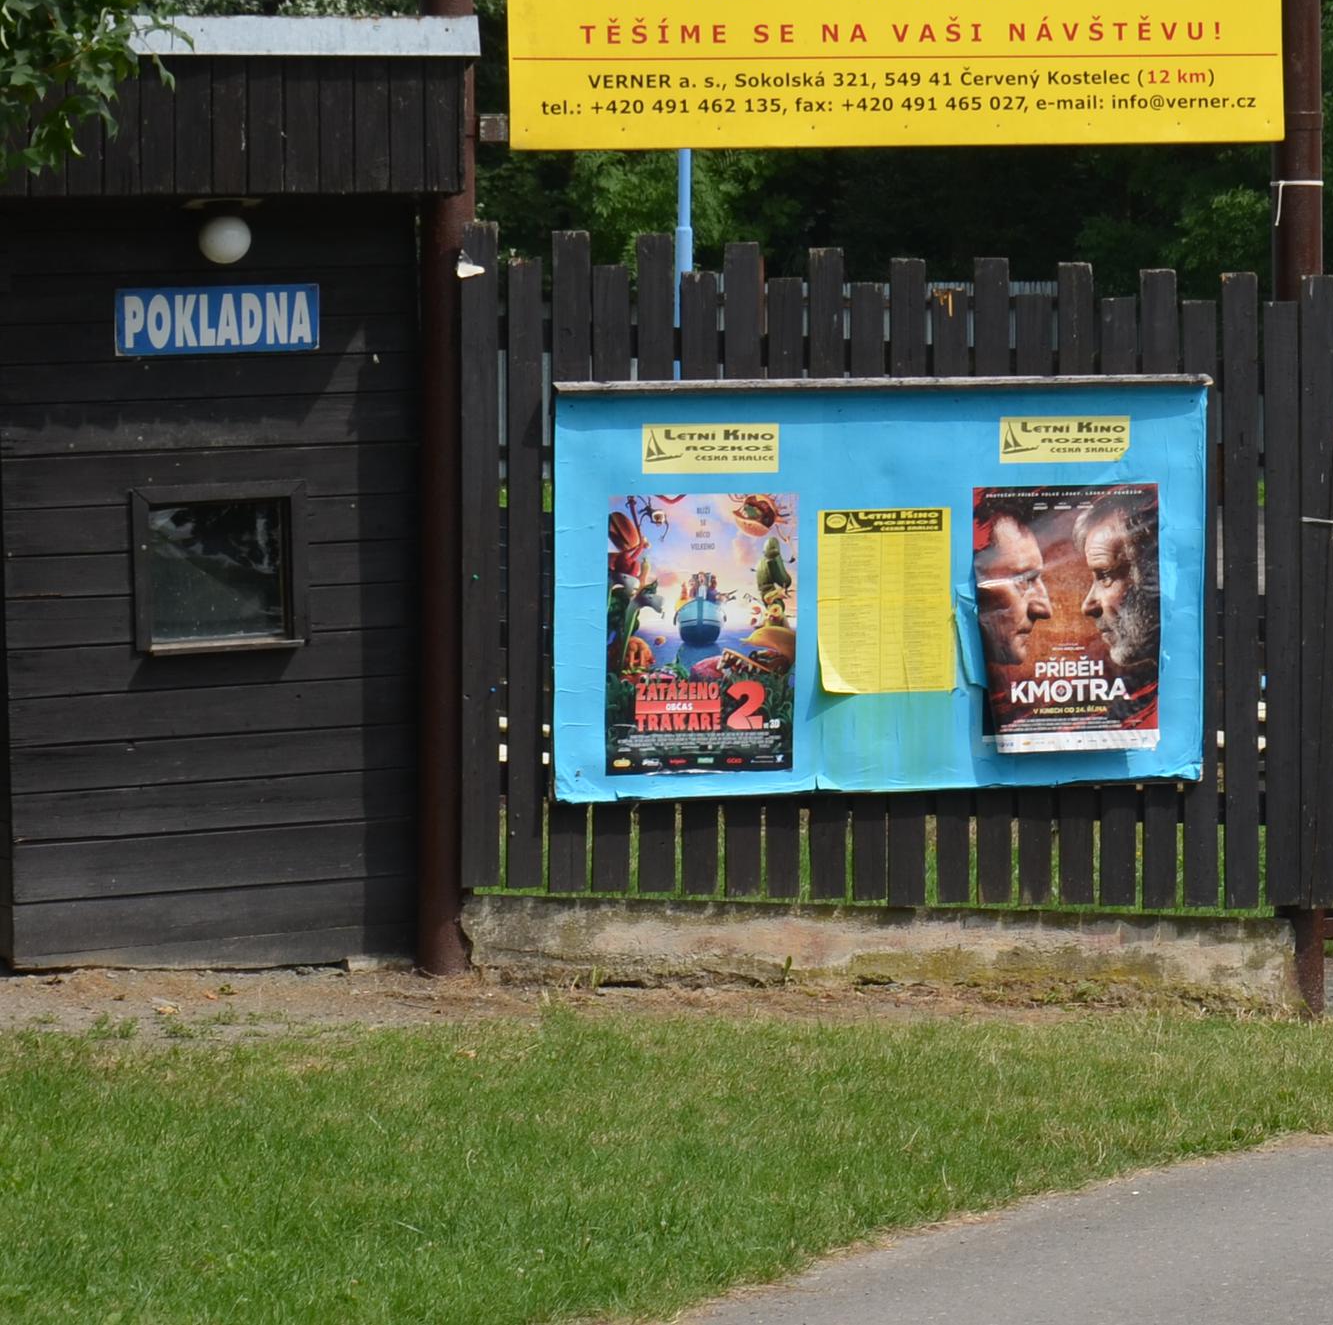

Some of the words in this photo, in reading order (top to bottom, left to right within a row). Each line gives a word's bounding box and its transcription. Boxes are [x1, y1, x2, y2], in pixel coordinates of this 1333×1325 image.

[579, 17, 727, 45] TĚŠÍME
[753, 23, 794, 44] SE
[821, 23, 868, 44] NA
[891, 15, 982, 43] VAŠI
[1008, 15, 1221, 42] NÁVŠTĚVU!
[587, 73, 672, 90] VERNER
[678, 76, 697, 89] a.
[704, 76, 727, 92] s.,
[734, 70, 825, 88] Sokolská
[833, 72, 877, 90] 321,
[884, 71, 921, 87] 549
[928, 71, 953, 87] 41
[959, 66, 1041, 90] Červený
[1047, 69, 1130, 86] Kostelec
[540, 99, 582, 116] tel.:
[590, 99, 645, 115] +420
[651, 98, 690, 114] 491
[697, 98, 736, 114] 462
[744, 97, 788, 116] 135,
[794, 96, 833, 113] fax:
[841, 96, 894, 112] +420
[900, 96, 937, 112] 491
[945, 96, 982, 111] 465
[989, 95, 1029, 114] 027,
[1035, 94, 1104, 111] e-mail:
[1111, 93, 1257, 111] info@verner.cz
[123, 290, 314, 350] POKLADNA
[723, 429, 775, 441] KINO
[1077, 422, 1126, 433] KINO
[1034, 655, 1105, 678] PŘÍBĚH
[1010, 677, 1132, 704] KMOTRA
[726, 680, 766, 730] 2
